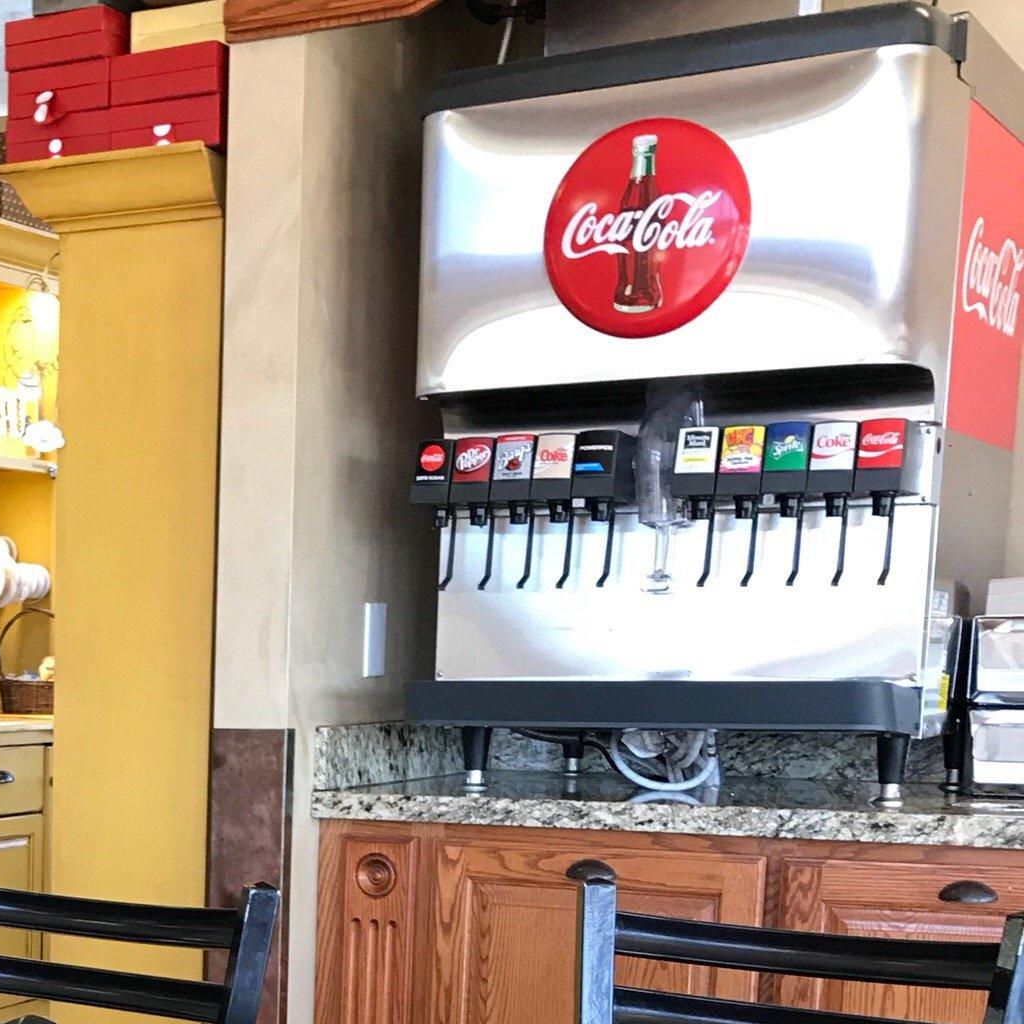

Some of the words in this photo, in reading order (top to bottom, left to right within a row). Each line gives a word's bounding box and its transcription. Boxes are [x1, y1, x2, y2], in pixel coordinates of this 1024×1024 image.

[561, 189, 722, 260] Coca-Cola
[816, 436, 849, 449] Coke
[540, 449, 568, 462] Coke
